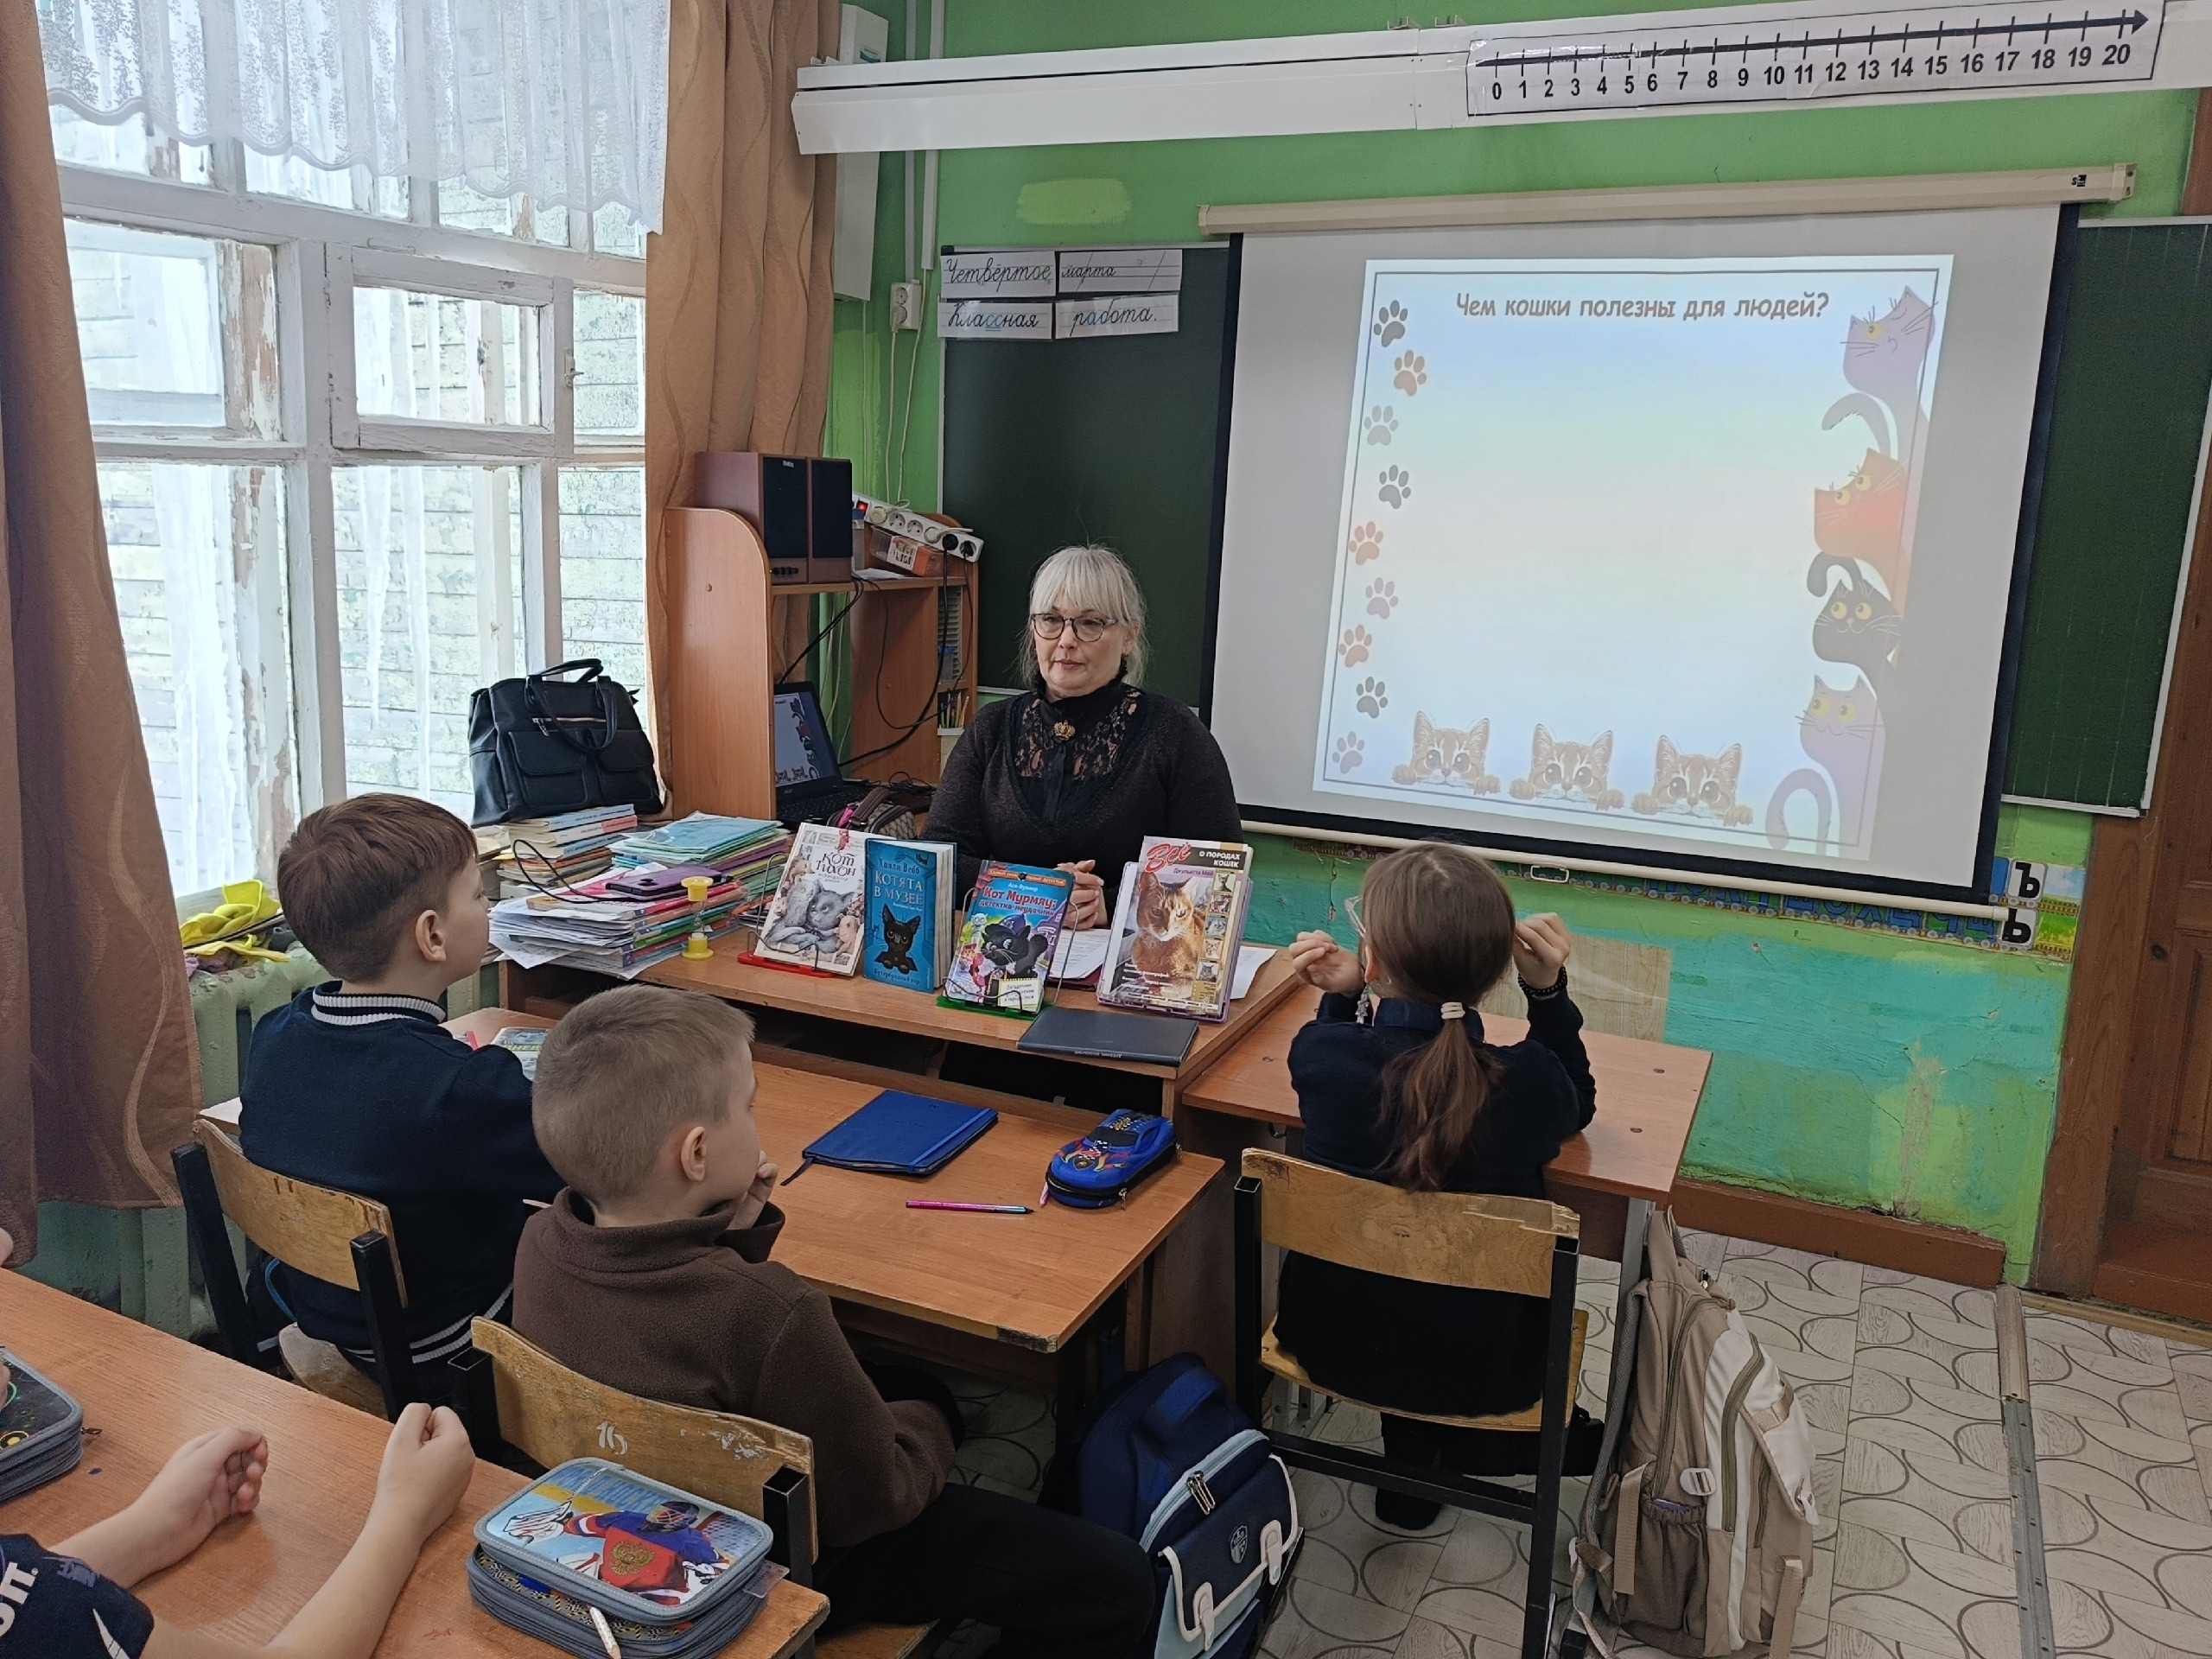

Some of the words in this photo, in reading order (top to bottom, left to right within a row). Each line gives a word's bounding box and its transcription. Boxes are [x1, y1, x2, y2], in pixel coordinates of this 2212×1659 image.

[1492, 82, 1502, 100] 0
[1519, 80, 1527, 99] 1
[1544, 79, 1554, 98] 2
[1571, 78, 1580, 96] 3
[1597, 76, 1608, 95] 4
[1624, 75, 1635, 94] 5
[1647, 73, 1658, 92] 6
[1677, 71, 1688, 90] 7
[1707, 70, 1718, 88] 8
[1738, 68, 1749, 86] 9
[1764, 66, 1785, 86] 10
[1794, 64, 1814, 85] 11
[1825, 61, 1847, 82] 12
[1857, 60, 1880, 80] 13
[1891, 57, 1914, 79] 14
[1924, 55, 1948, 76] 15
[1960, 53, 1985, 73] 16
[1995, 51, 2020, 72] 17
[2031, 48, 2056, 69] 18
[2068, 46, 2092, 67] 19
[2101, 43, 2131, 66] 20
[946, 257, 1052, 292] Четвёртое
[1062, 265, 1116, 286] марта
[949, 302, 1039, 328] Классная
[1070, 299, 1157, 337] работа.
[1456, 293, 1496, 316] Чем
[1504, 297, 1571, 316] кошки
[1580, 299, 1675, 319] полезны
[1683, 299, 1726, 321] для
[1733, 291, 1829, 320] людей?
[879, 858, 901, 871] Холли
[903, 862, 920, 874] Вебб
[1206, 850, 1241, 861] ПОРОДАХ
[875, 870, 923, 892] КОТЯТА
[2015, 861, 2040, 899] Ъ
[874, 886, 881, 897] В
[886, 888, 924, 905] МУЗЕЕ
[983, 887, 1005, 899] Кот
[1007, 890, 1057, 909] Мурмяу:
